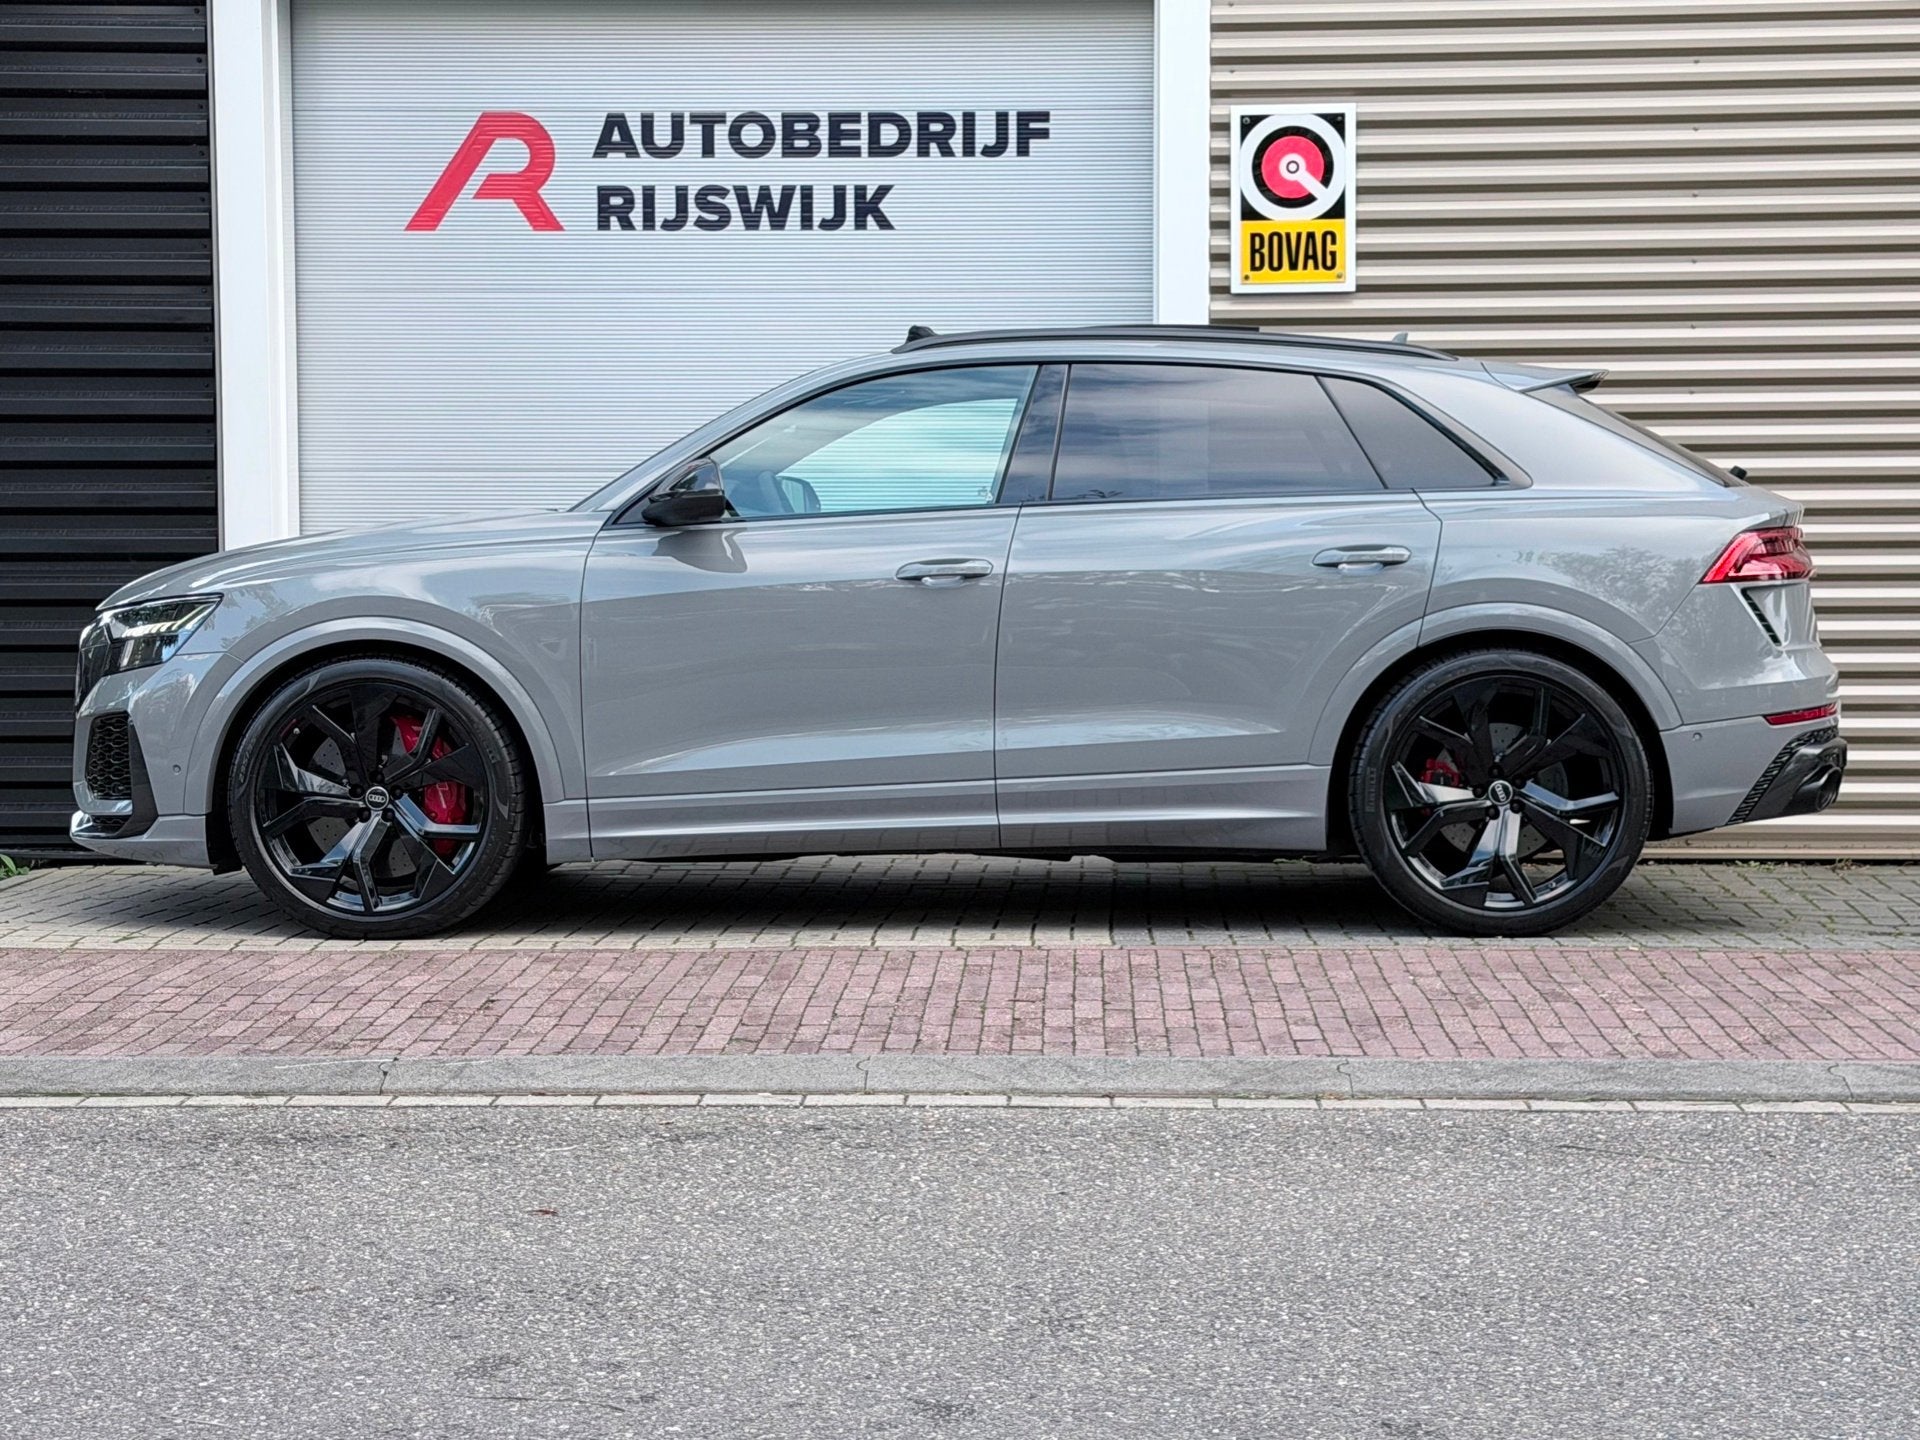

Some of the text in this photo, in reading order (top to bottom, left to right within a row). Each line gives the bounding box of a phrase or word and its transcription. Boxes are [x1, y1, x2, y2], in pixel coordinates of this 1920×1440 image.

[593, 111, 1050, 158] AUTOBEDRIJF
[597, 185, 894, 231] RIJSWIJK
[1250, 231, 1336, 271] BOVAG
